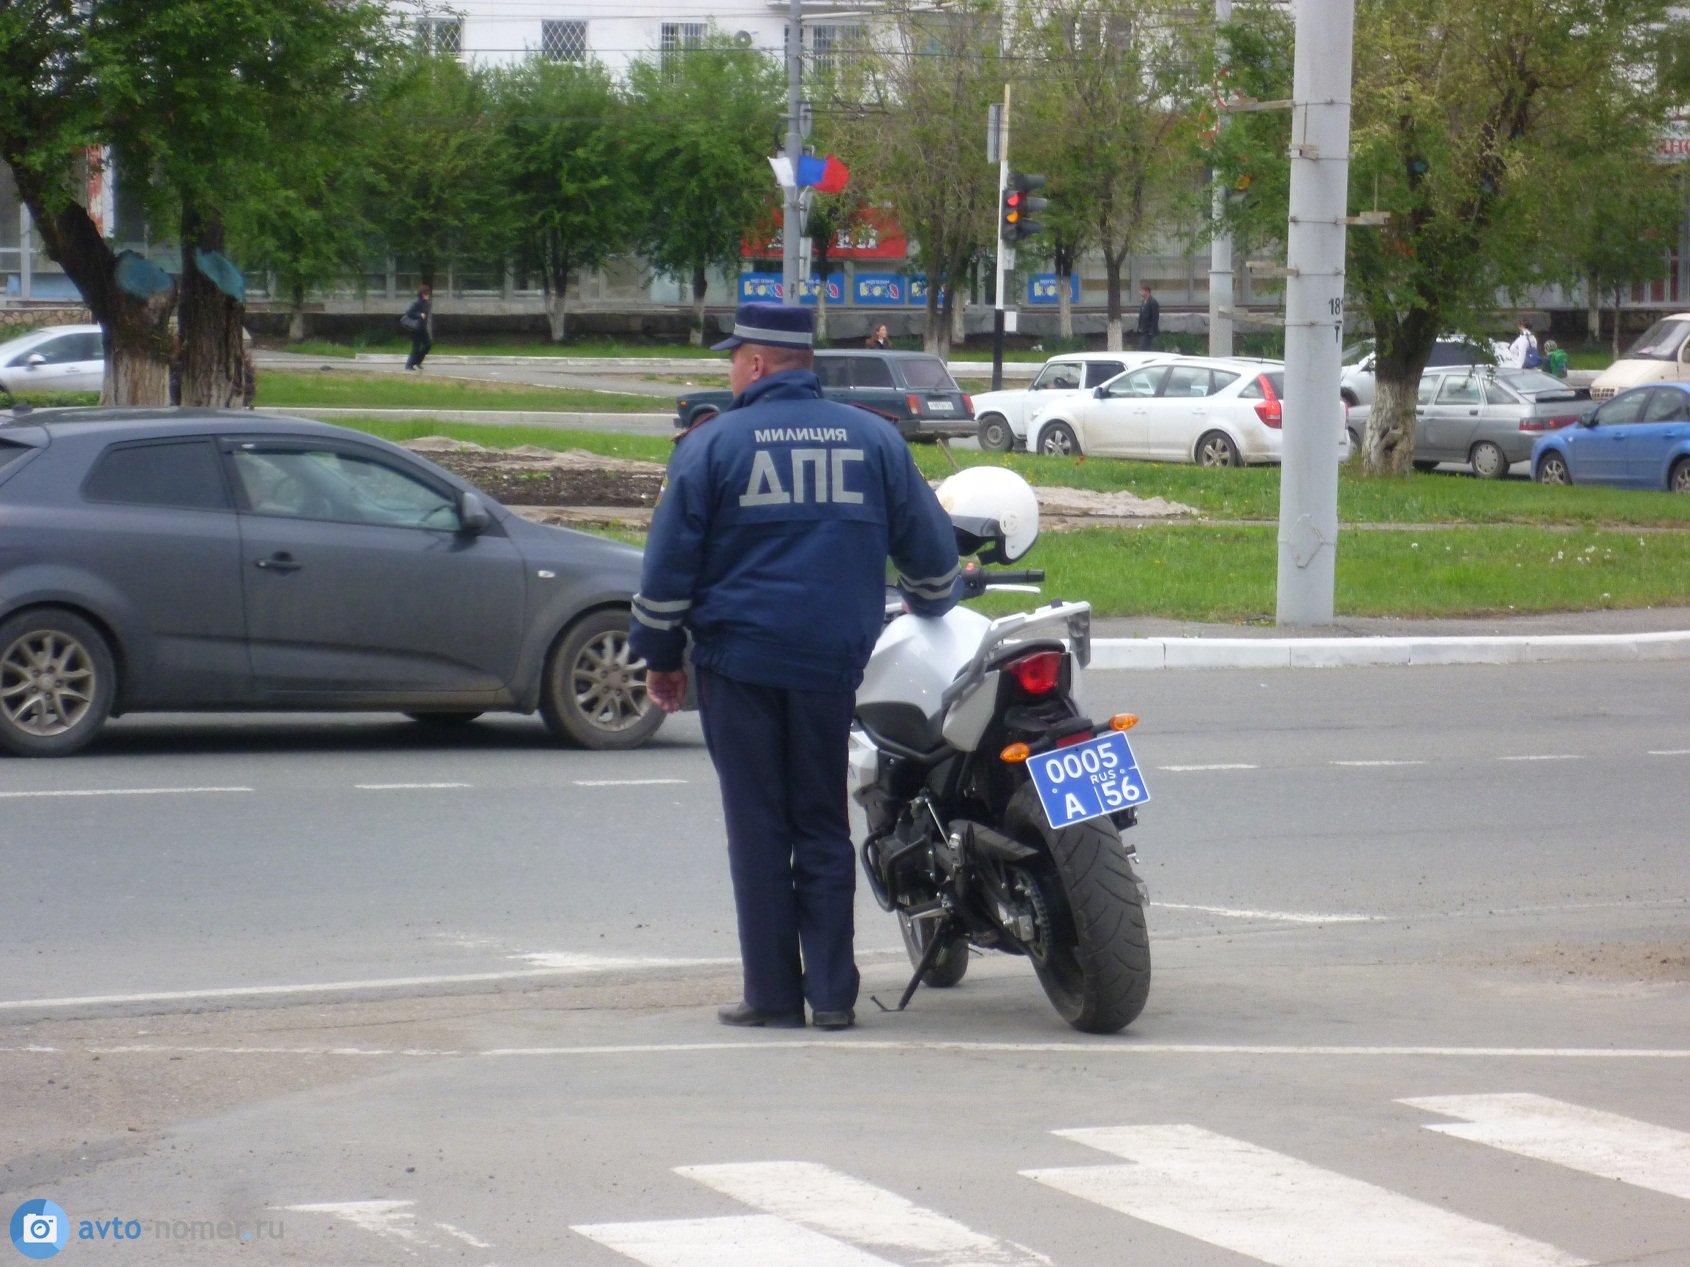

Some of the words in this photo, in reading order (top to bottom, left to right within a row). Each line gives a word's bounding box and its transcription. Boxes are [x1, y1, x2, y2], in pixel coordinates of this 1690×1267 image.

[754, 427, 848, 443] МИЛИЦИЯ
[739, 448, 864, 507] ДПС
[1045, 742, 1118, 784] 0005
[1090, 769, 1117, 785] RUS
[1101, 776, 1140, 806] 56
